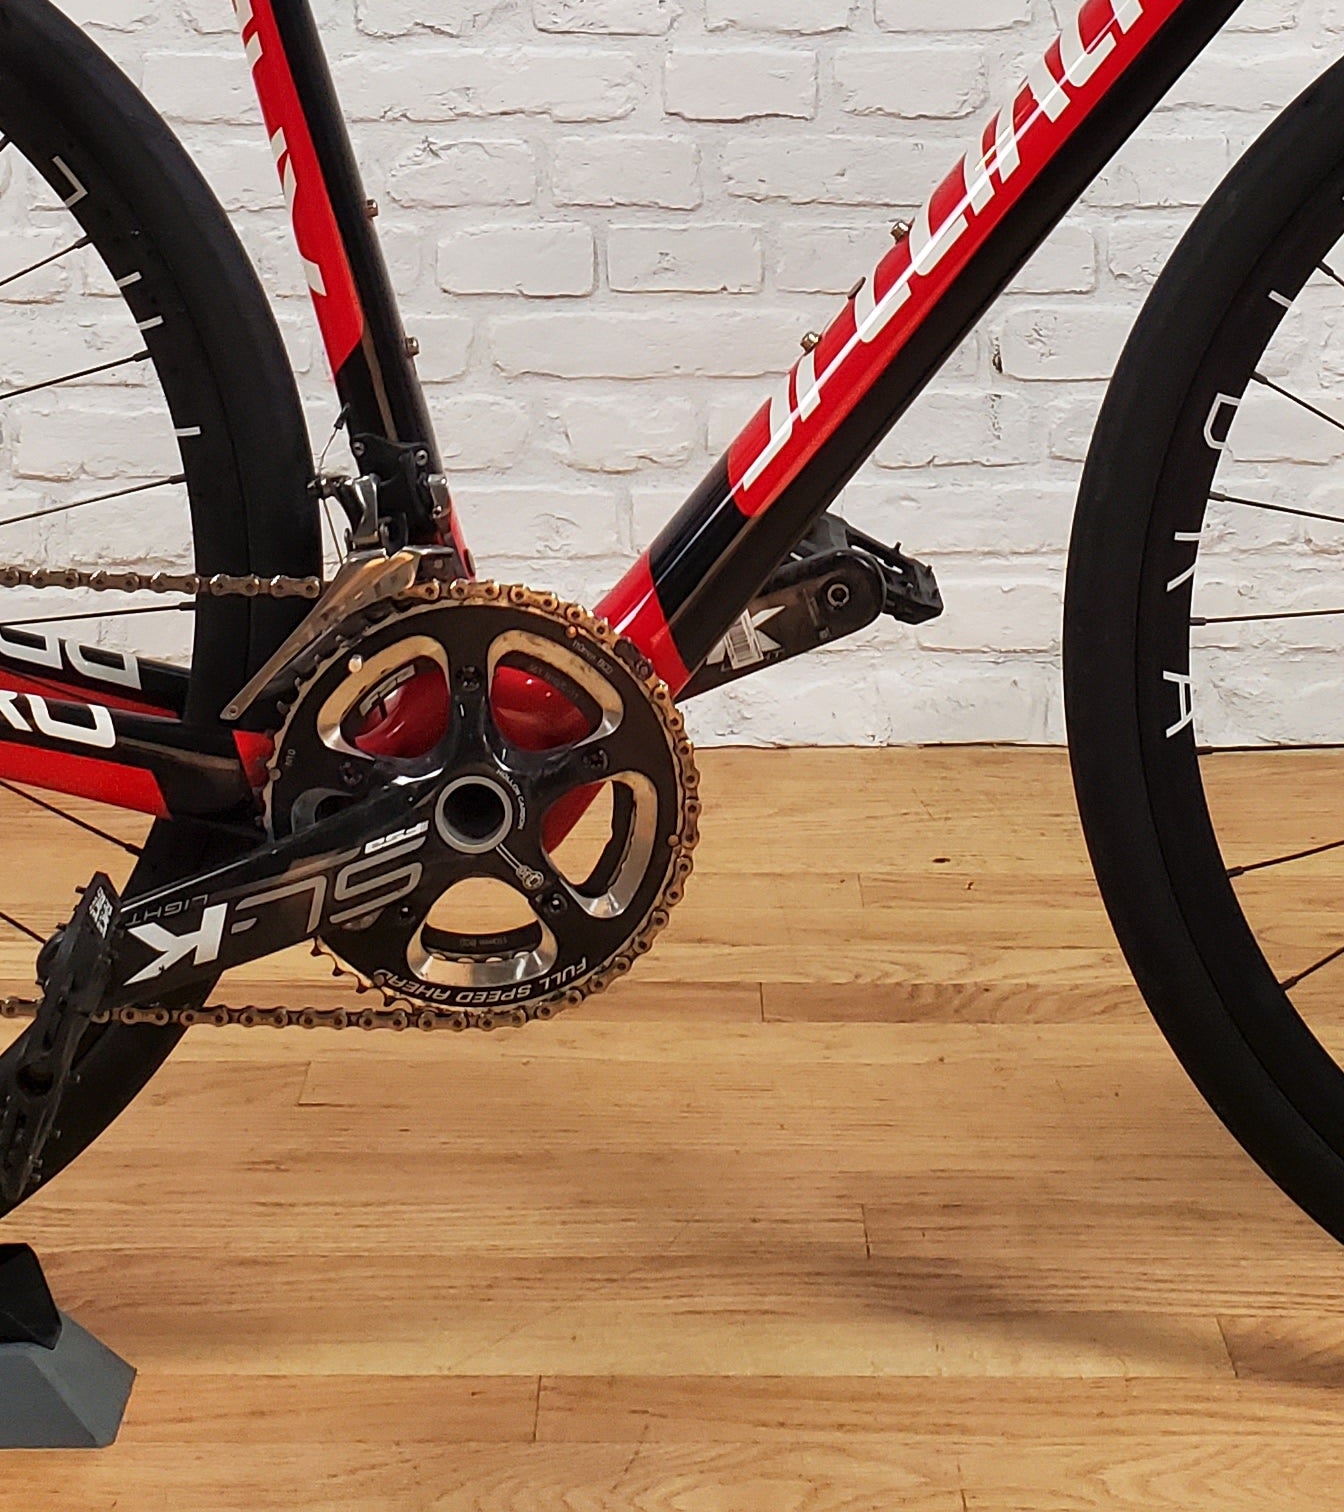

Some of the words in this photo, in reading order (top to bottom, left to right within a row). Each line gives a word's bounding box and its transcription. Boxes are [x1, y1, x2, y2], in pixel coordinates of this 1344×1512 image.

[126, 893, 209, 926] LIGHT
[373, 967, 451, 1001] AHEAD
[537, 954, 587, 992] FULL
[454, 983, 533, 1004] SPEED
